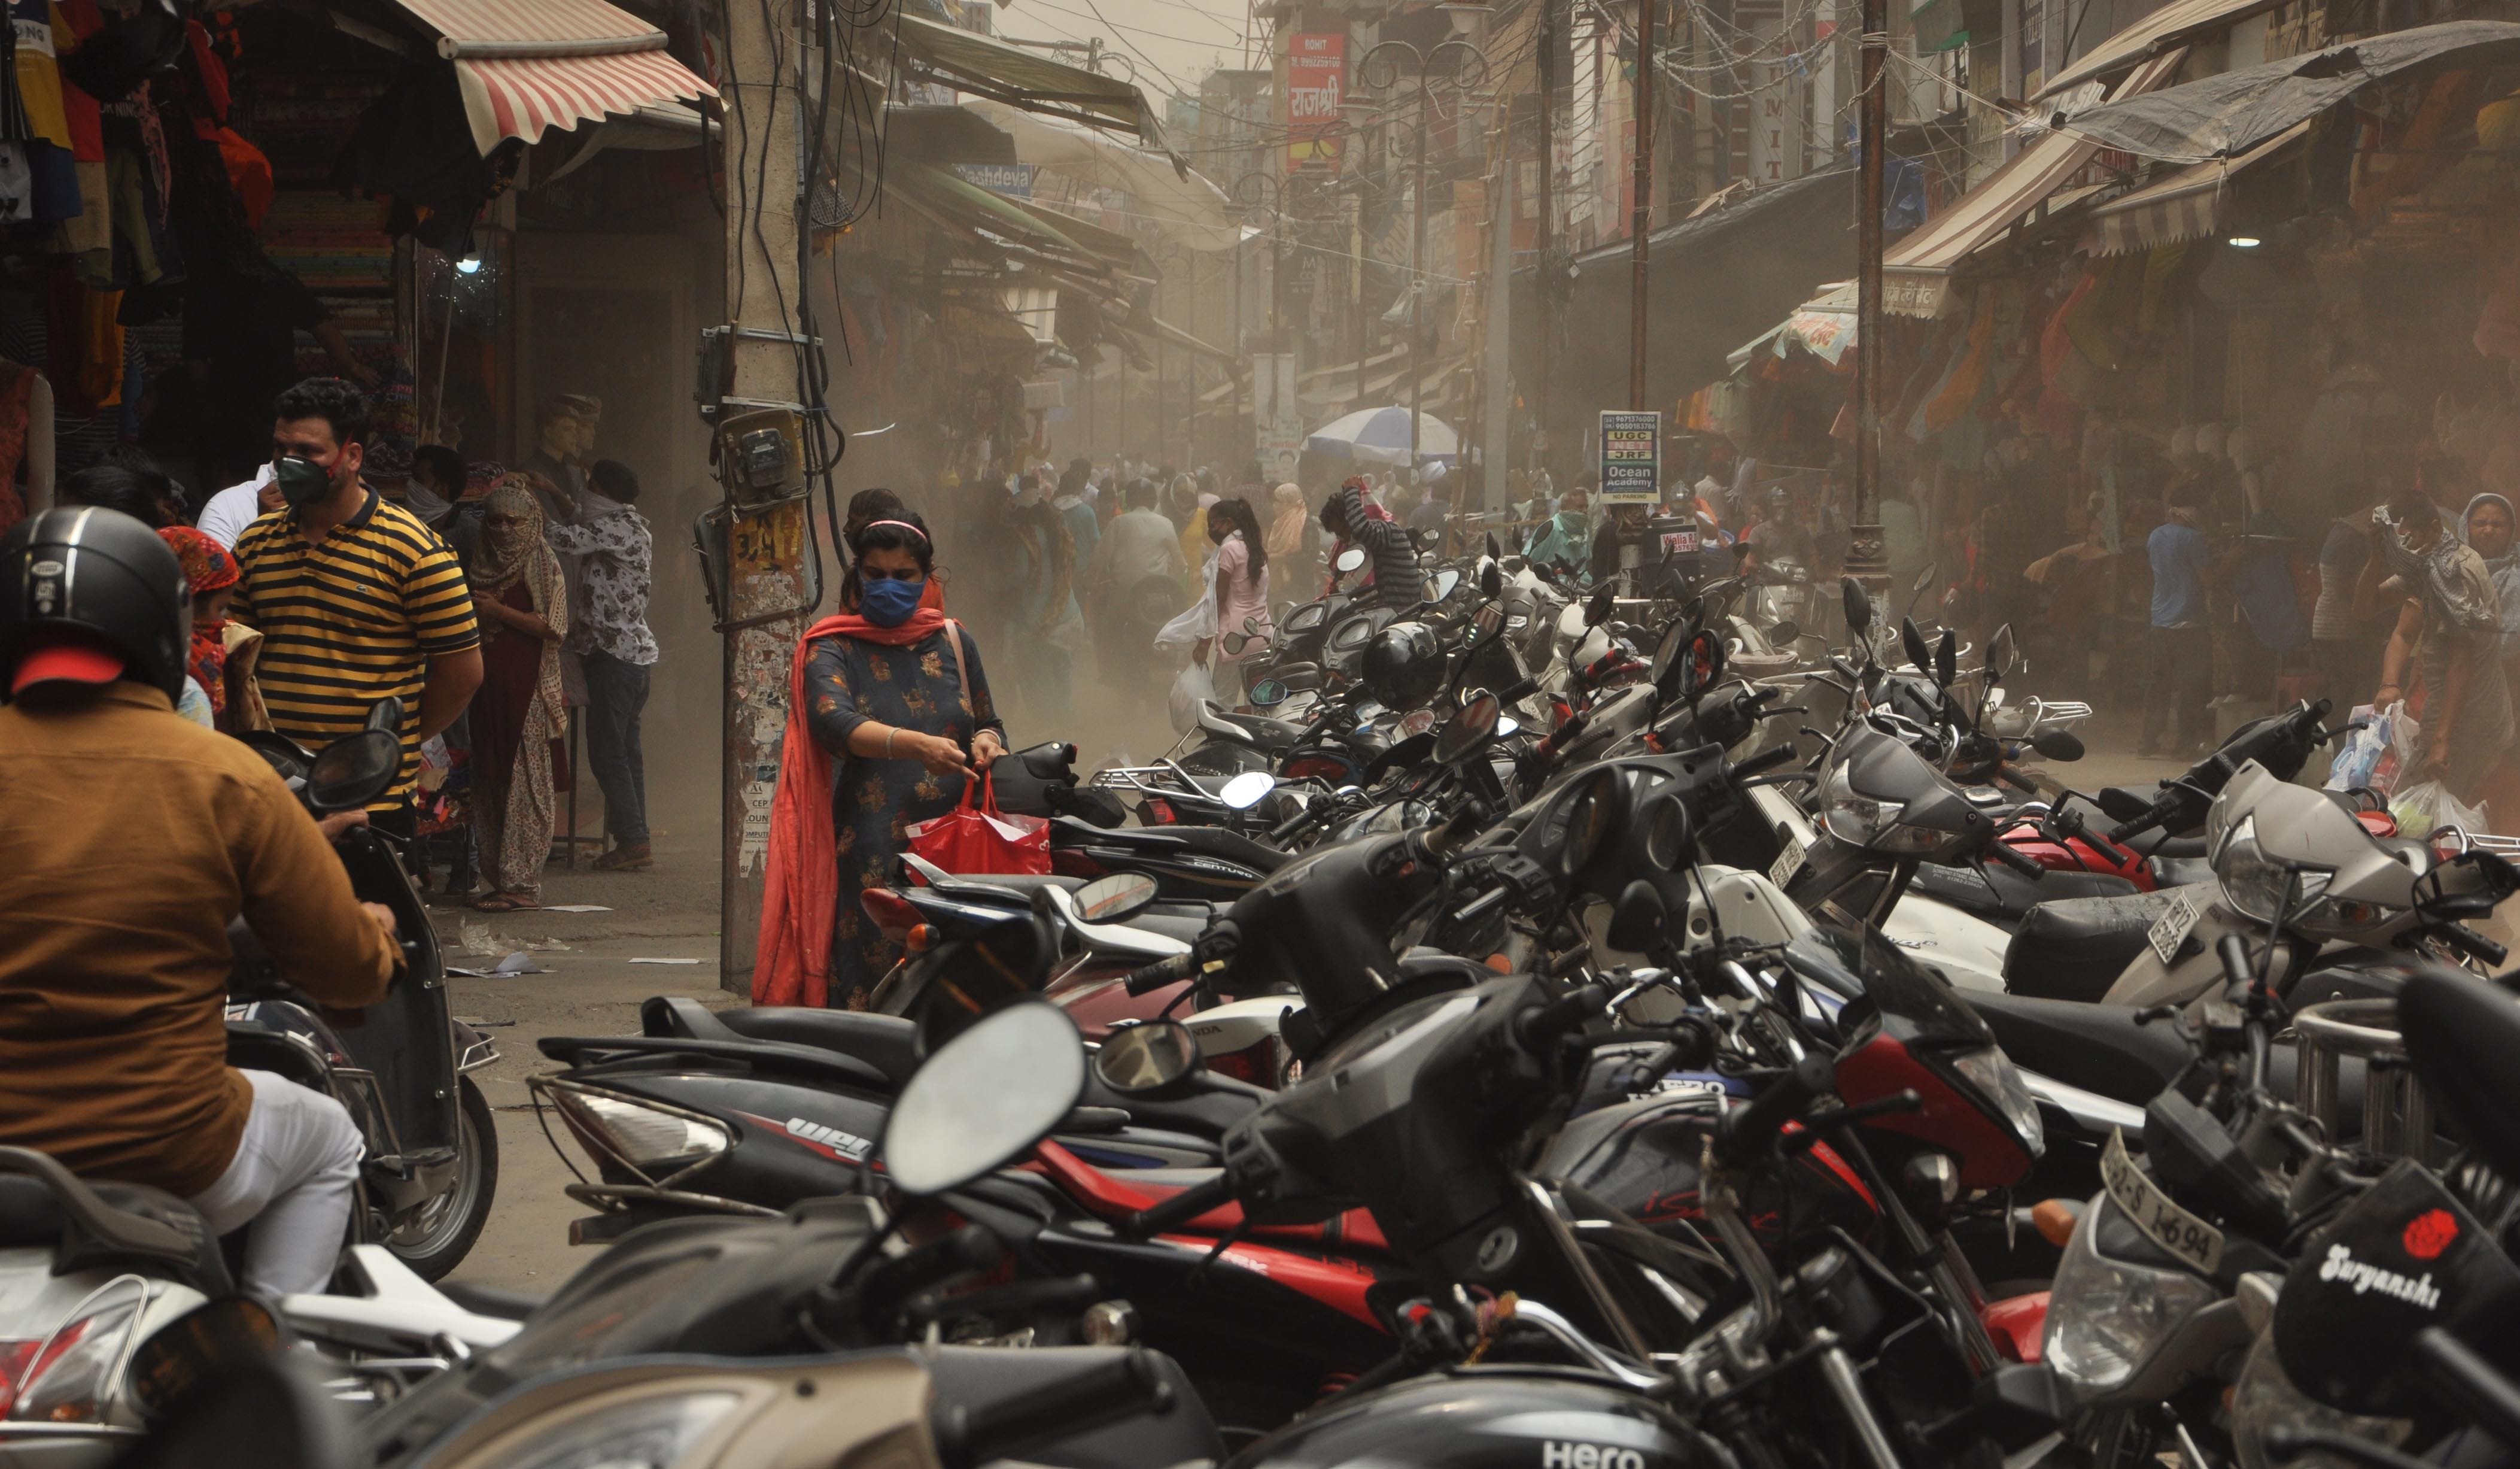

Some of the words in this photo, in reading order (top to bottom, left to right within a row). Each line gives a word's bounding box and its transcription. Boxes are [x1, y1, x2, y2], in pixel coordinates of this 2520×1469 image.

[1305, 39, 1327, 51] ROHIT
[1609, 466, 1650, 477] Ocean
[1607, 479, 1652, 487] Academy
[1191, 1025, 1223, 1036] NDA
[1543, 1440, 1645, 1468] Hero
